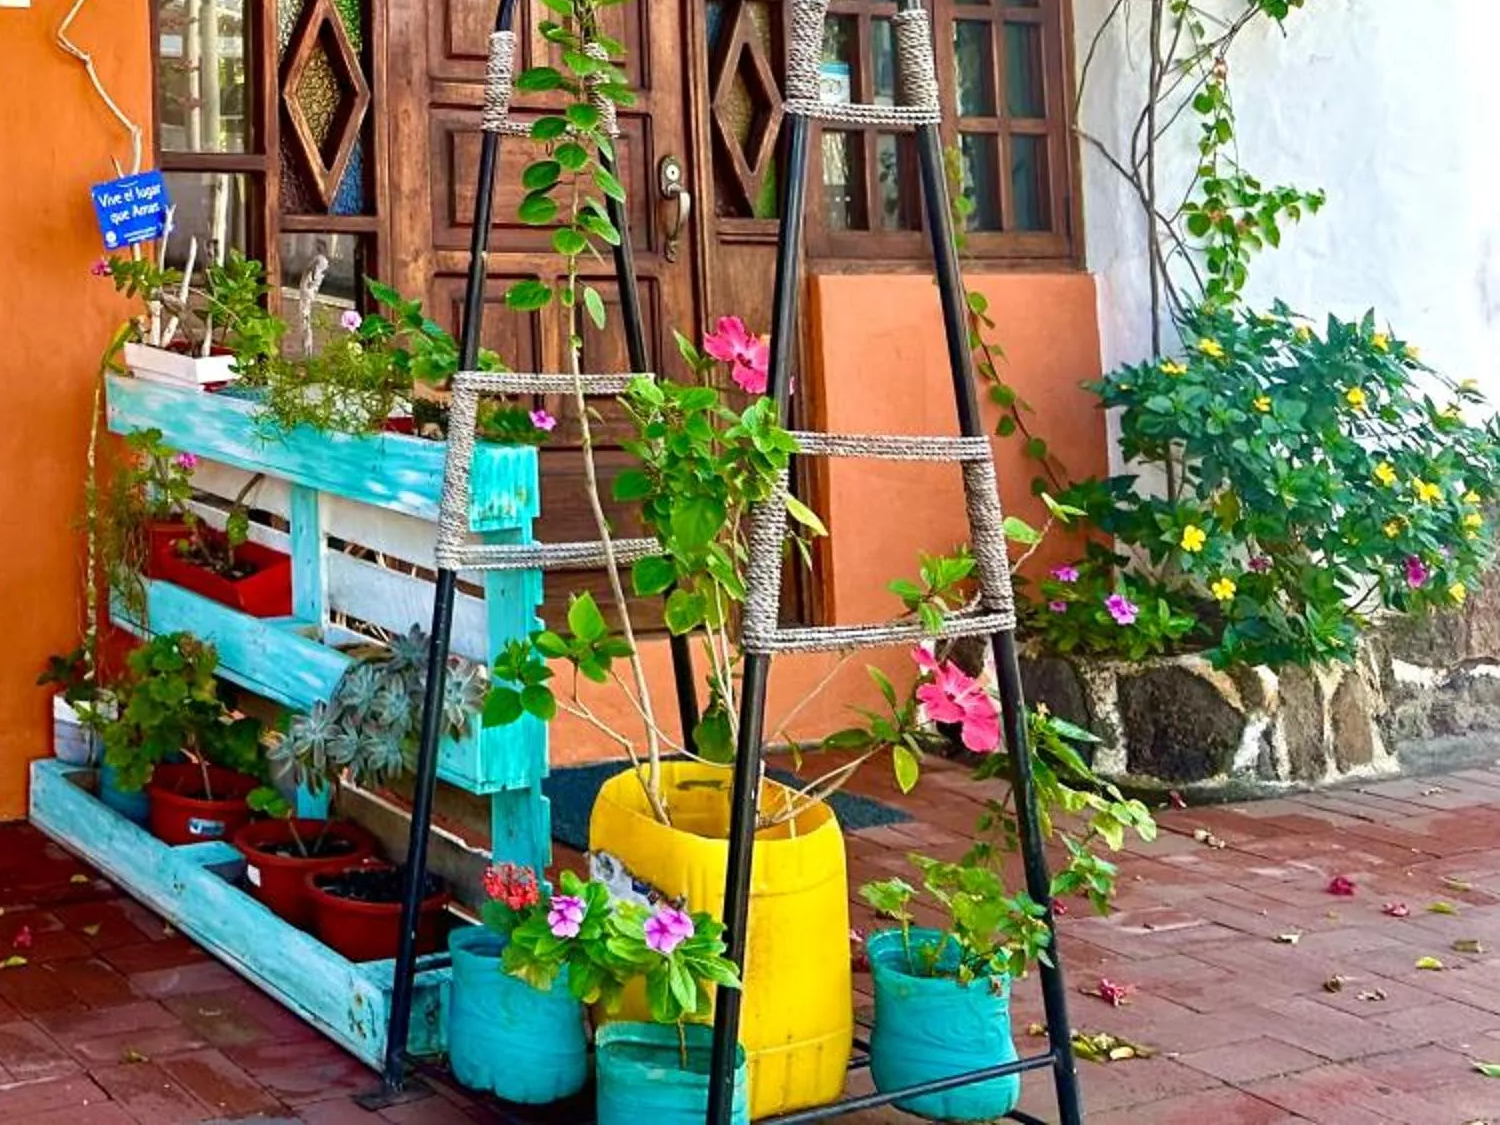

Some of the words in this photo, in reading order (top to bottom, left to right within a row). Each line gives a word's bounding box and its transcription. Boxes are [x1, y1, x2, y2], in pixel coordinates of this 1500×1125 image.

[98, 193, 123, 208] Vive
[124, 188, 135, 202] el
[135, 184, 161, 200] lugar
[110, 210, 131, 226] que
